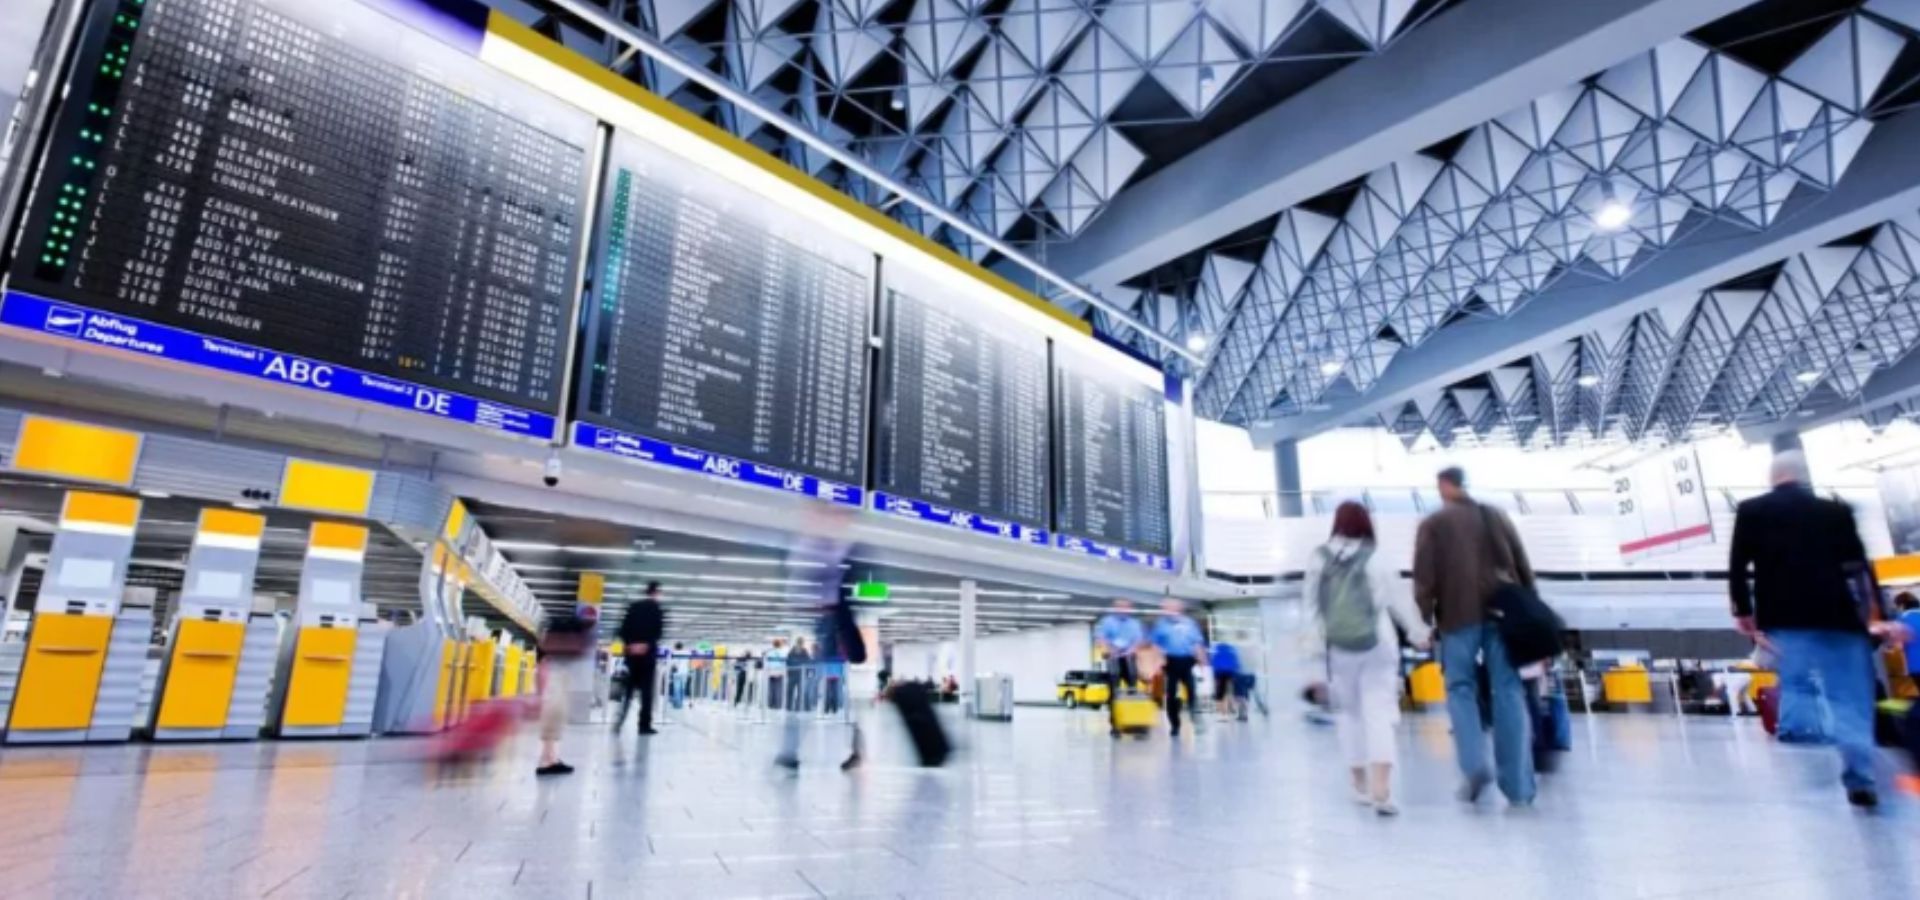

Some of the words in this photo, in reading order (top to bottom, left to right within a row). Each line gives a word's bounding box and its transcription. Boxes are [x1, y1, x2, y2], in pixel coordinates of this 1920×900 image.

[214, 159, 277, 187] HOUSTON
[218, 147, 279, 175] DETROIT
[205, 197, 259, 222] ZAGREB
[194, 235, 240, 257] ADDIS
[200, 222, 223, 239] TEL
[234, 234, 271, 251] AVIV
[188, 261, 270, 293] LJUBLJANA
[191, 249, 297, 287] BERLIN-TEGEL
[184, 274, 242, 298] DUBLIN
[180, 287, 237, 311] BERGEN
[87, 313, 138, 337] Abflug
[177, 301, 261, 331] STAVANGER
[83, 327, 164, 353] Departures
[202, 338, 256, 361] Terminal
[263, 355, 333, 388] ABC
[360, 374, 405, 395] Terminal
[414, 388, 451, 416] DE
[703, 455, 740, 479] ABC
[1673, 456, 1688, 473] 10
[783, 472, 804, 492] DE
[1614, 477, 1631, 494] 20
[1676, 478, 1694, 497] 10
[1618, 498, 1634, 515] 20
